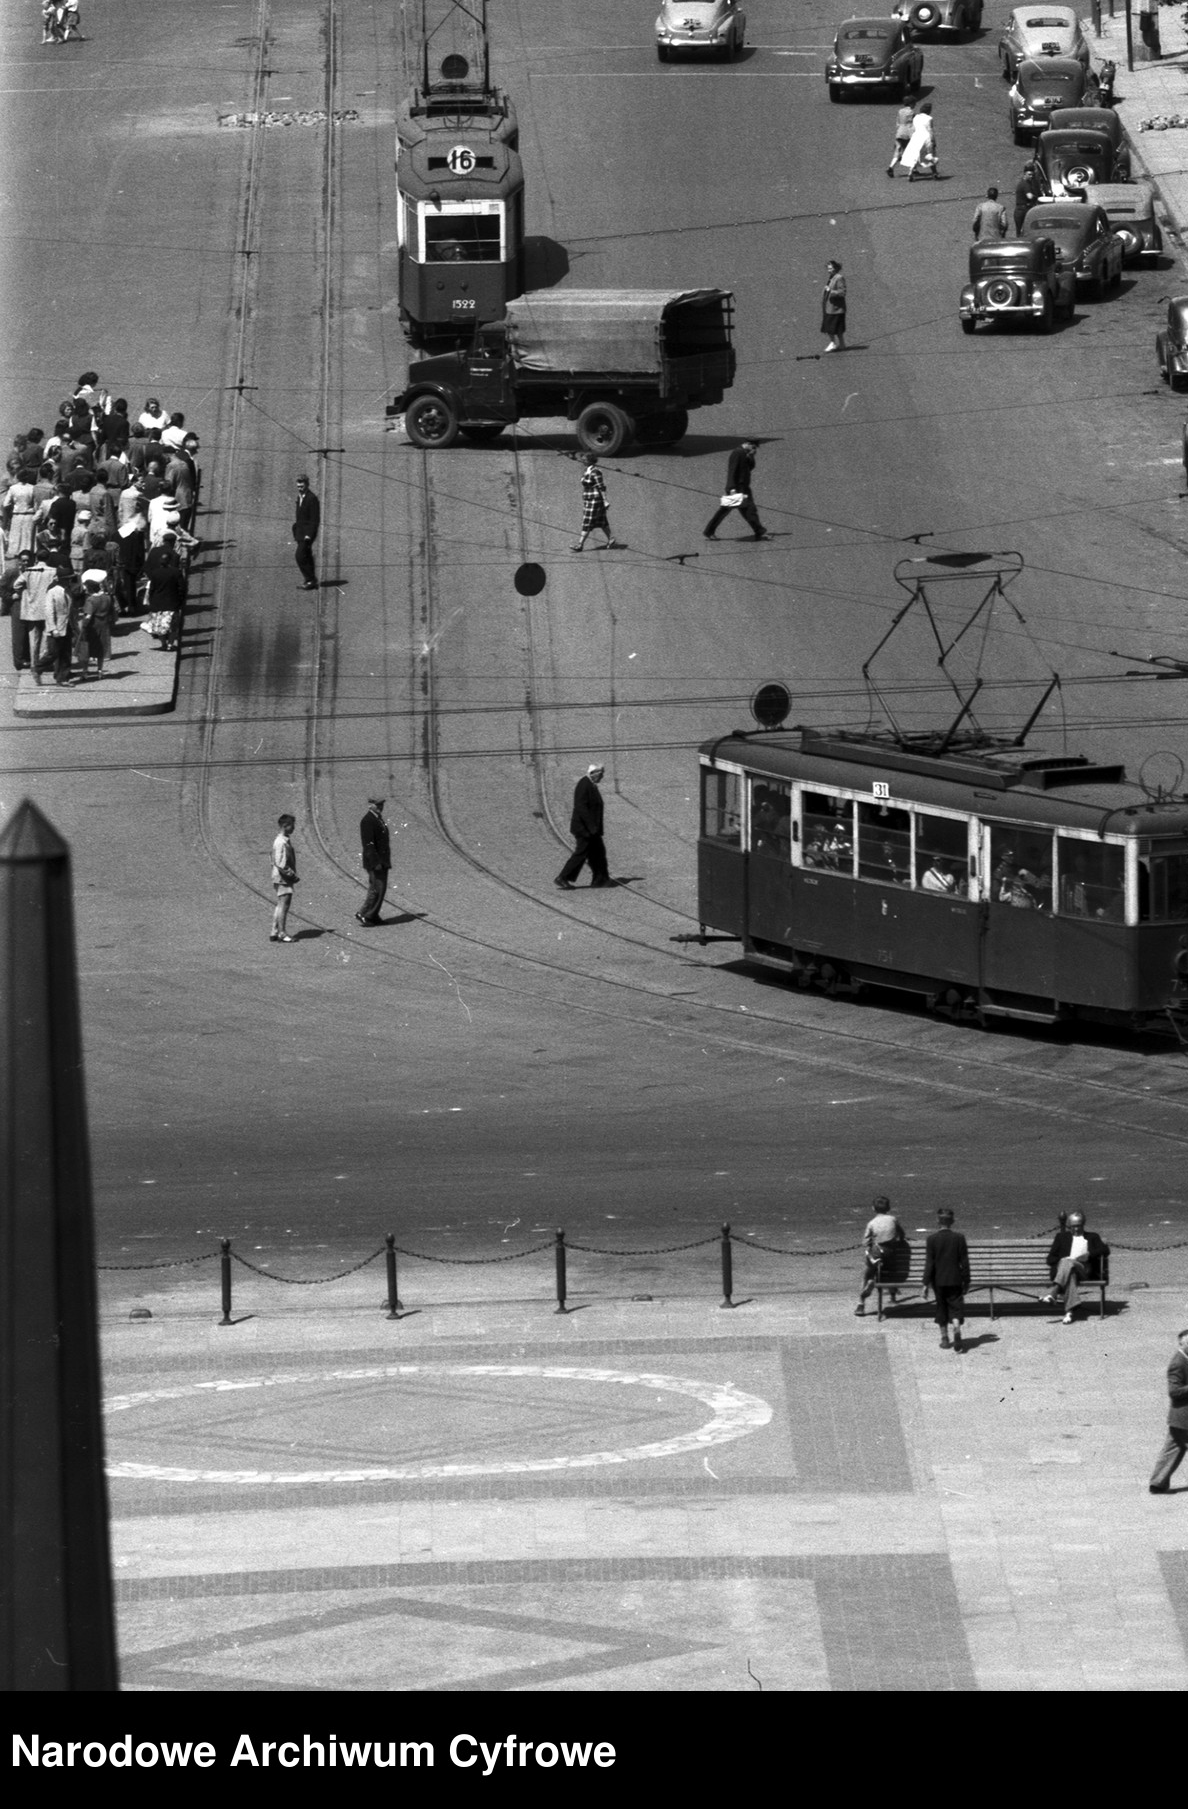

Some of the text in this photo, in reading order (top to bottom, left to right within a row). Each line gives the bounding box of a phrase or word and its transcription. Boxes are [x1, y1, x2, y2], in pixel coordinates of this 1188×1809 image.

[450, 149, 473, 171] 16
[451, 299, 476, 310] 1522
[874, 783, 889, 797] 31
